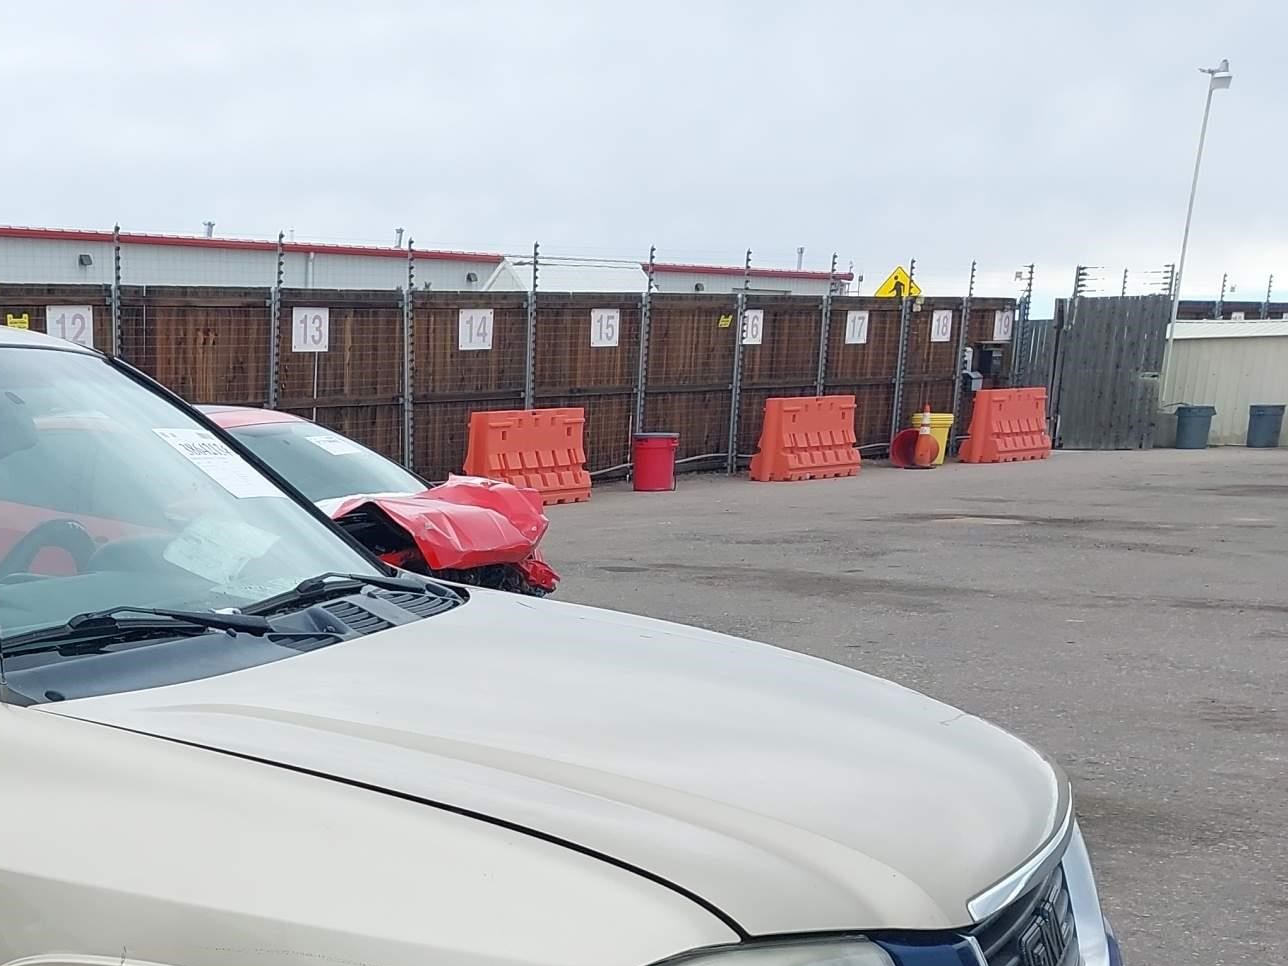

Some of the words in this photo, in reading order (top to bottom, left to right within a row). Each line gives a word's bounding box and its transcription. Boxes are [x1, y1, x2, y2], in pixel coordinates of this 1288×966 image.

[55, 312, 87, 345] 12
[299, 313, 323, 345] 13
[465, 315, 488, 344] 14
[597, 314, 616, 342] 15
[850, 314, 866, 338] 17
[935, 313, 950, 337] 18
[997, 314, 1011, 337] 19
